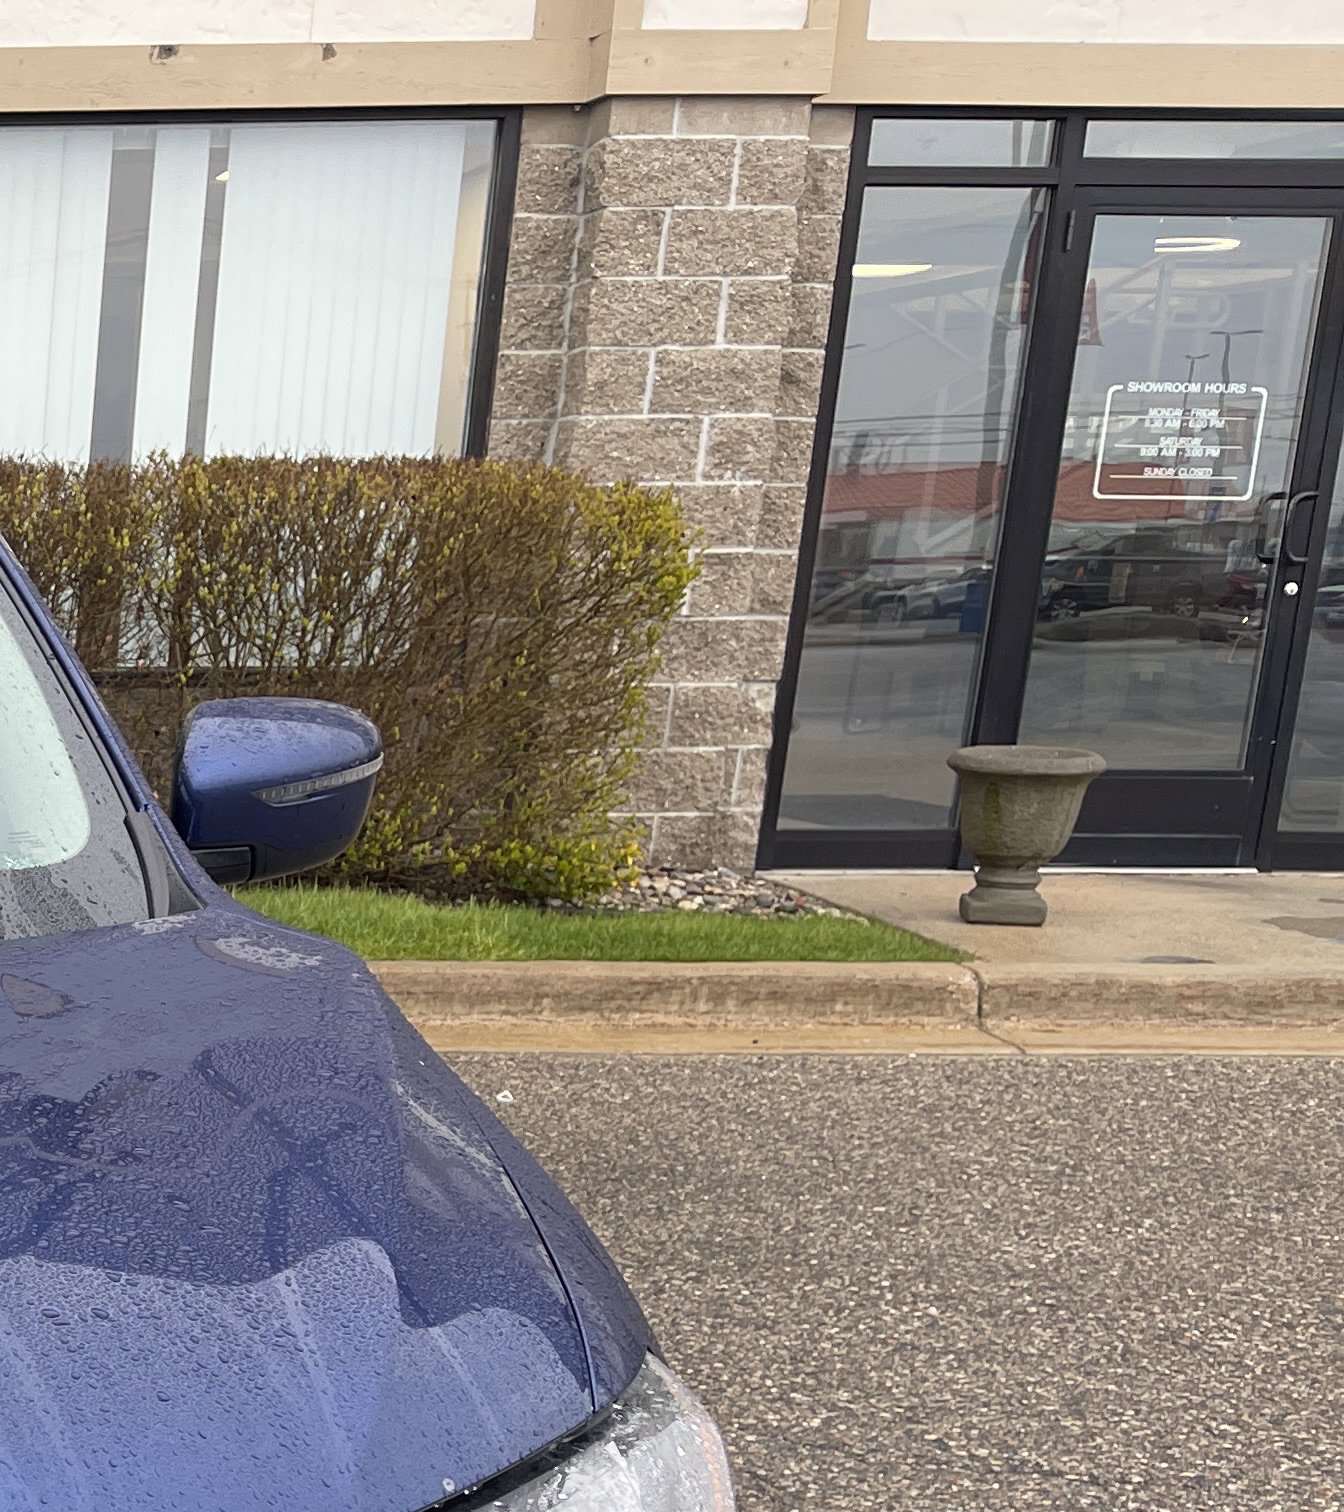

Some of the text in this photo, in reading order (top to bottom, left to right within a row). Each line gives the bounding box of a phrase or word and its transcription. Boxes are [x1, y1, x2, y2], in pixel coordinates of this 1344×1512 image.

[1126, 382, 1247, 394] SHOWROOM HOURS
[1148, 408, 1184, 417] MONDAY
[1190, 408, 1221, 417] FRIDAY
[1159, 436, 1204, 447] SATURDAY
[1143, 467, 1213, 477] SUNDAY CLOSED
